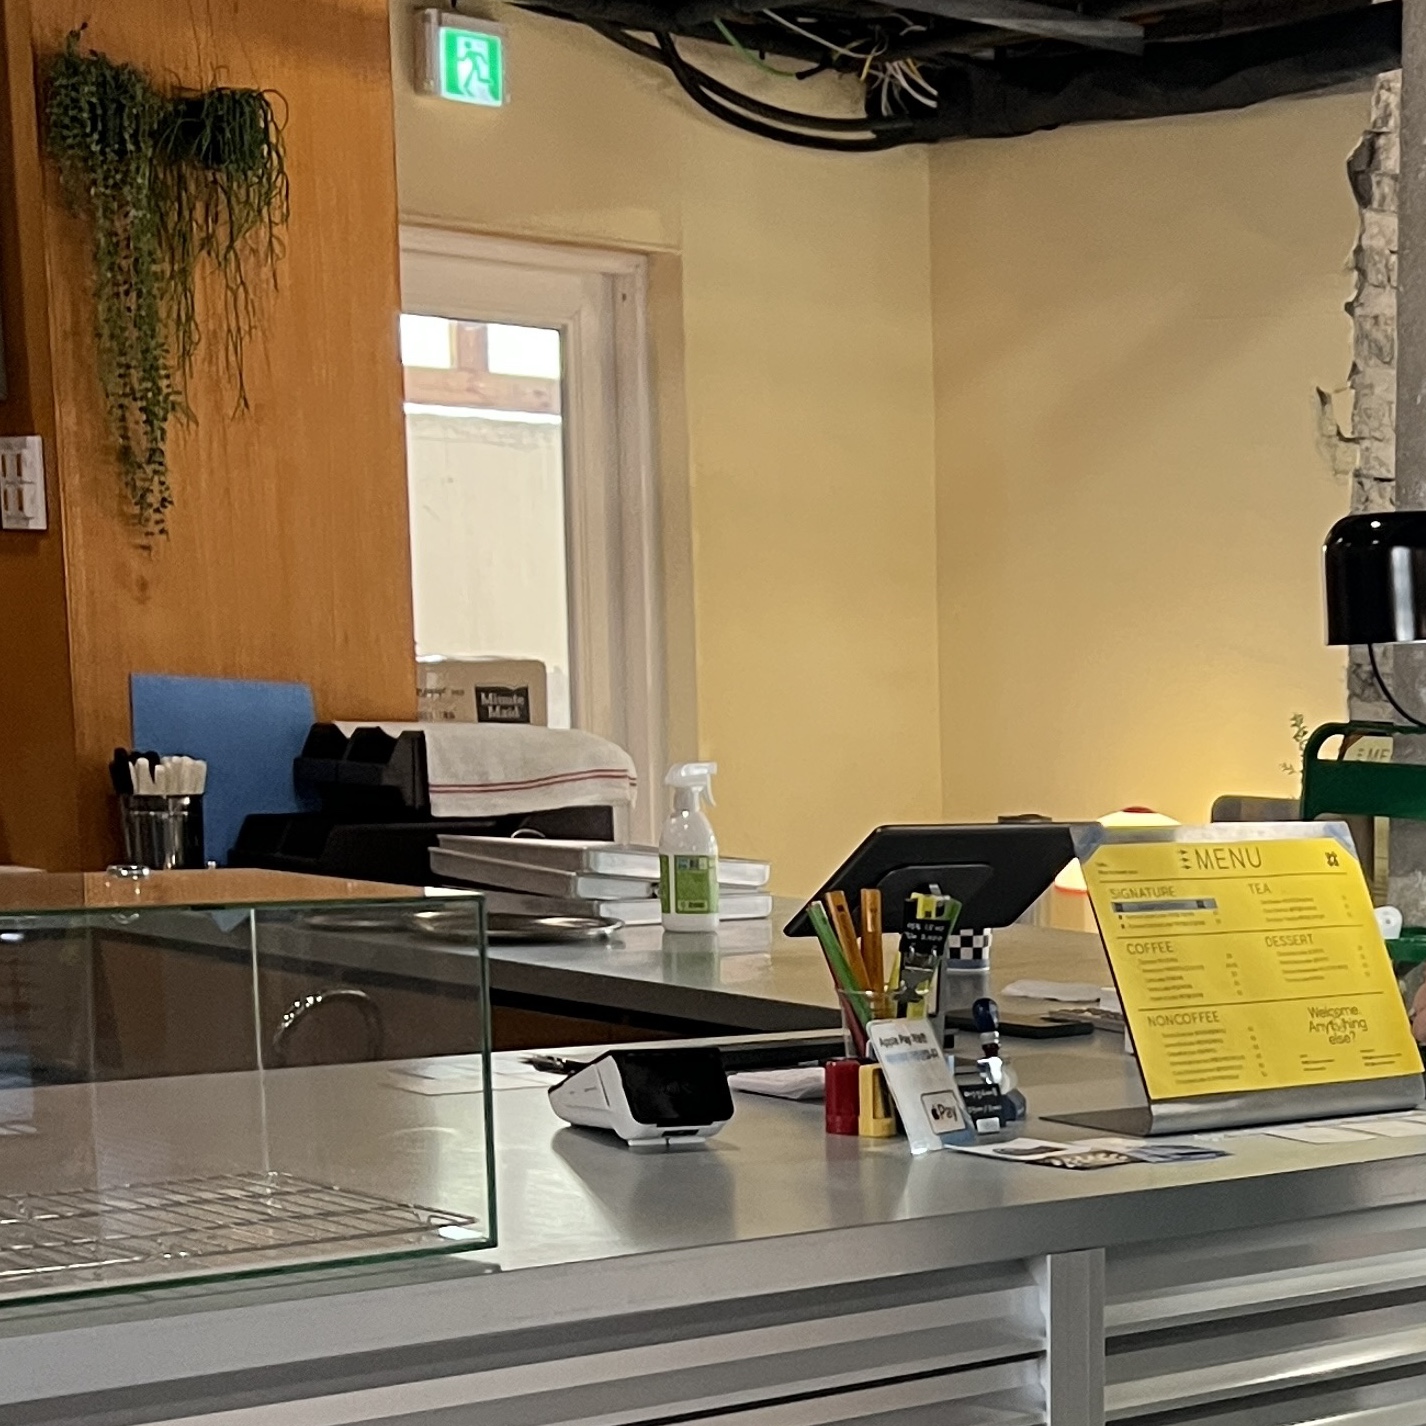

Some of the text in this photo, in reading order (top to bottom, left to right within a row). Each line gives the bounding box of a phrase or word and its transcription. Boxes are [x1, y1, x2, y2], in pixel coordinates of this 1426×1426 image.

[1195, 847, 1262, 871] MENU
[1110, 886, 1176, 899] SIGNATURE
[1248, 883, 1271, 895] TEA
[1265, 933, 1314, 947] DESSERT
[1126, 941, 1174, 955] COFFEE
[1147, 1010, 1220, 1027] NONCOFFEE
[938, 1103, 958, 1122] Pay
